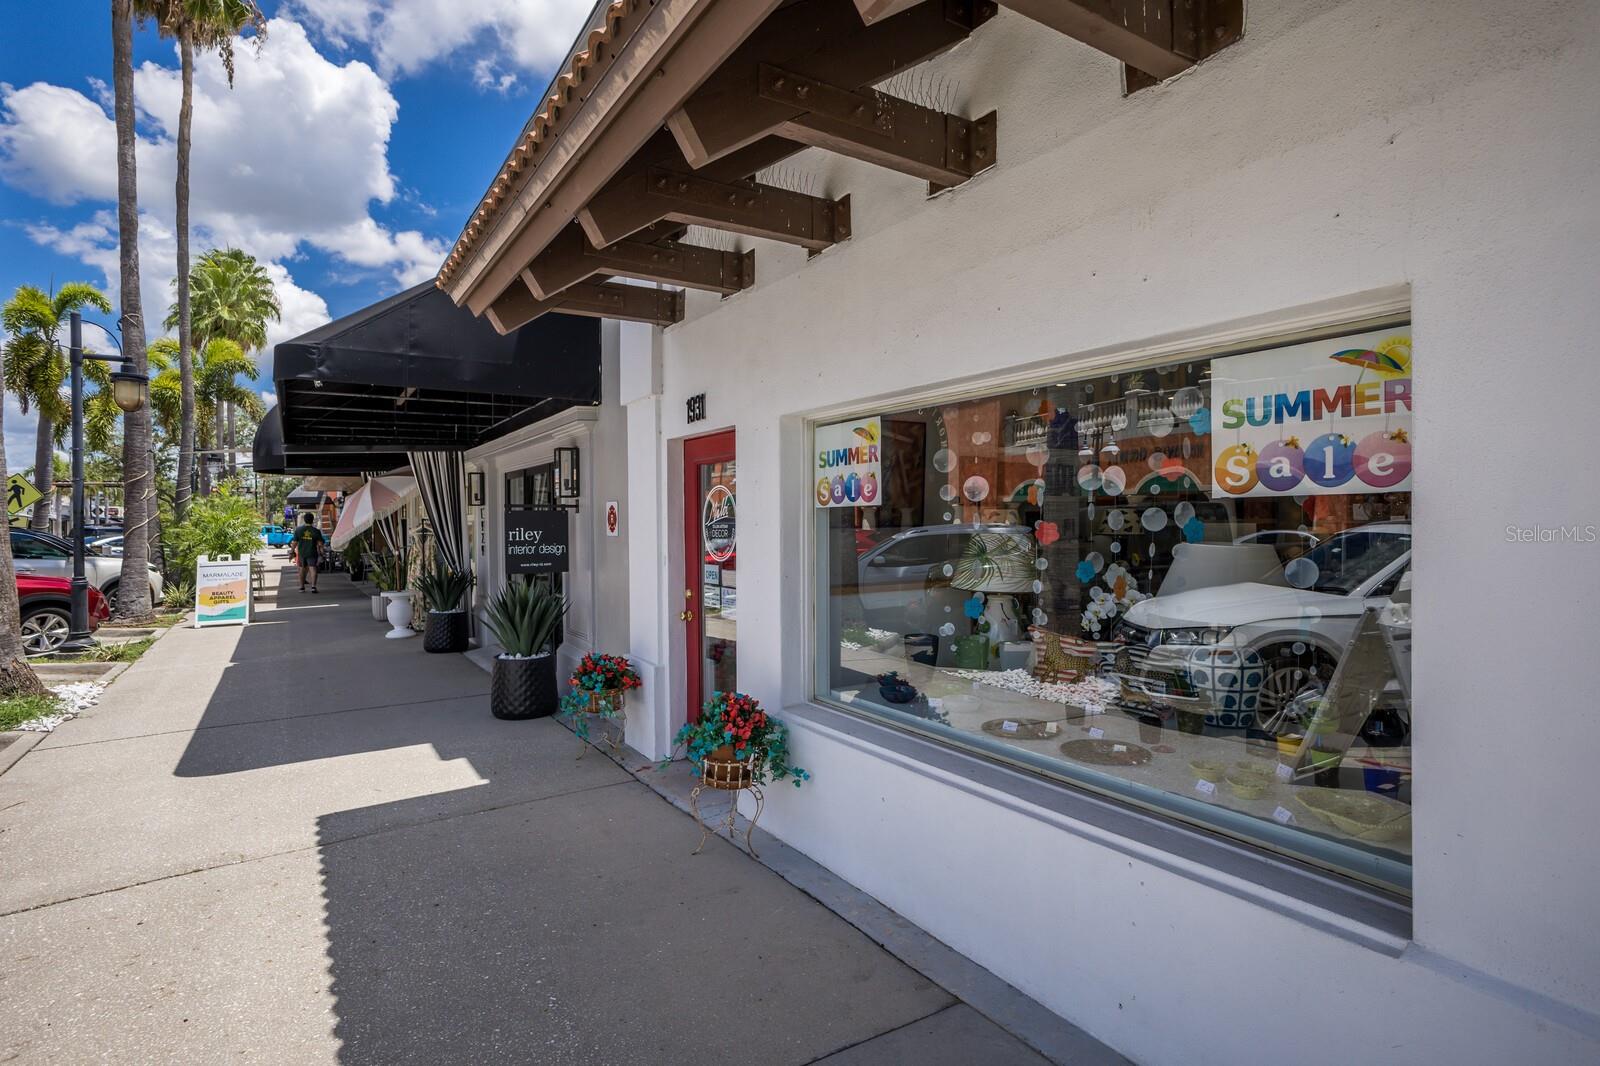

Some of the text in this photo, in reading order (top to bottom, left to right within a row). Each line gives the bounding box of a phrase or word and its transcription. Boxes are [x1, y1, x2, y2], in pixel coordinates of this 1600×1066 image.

[686, 392, 706, 424] 1931
[1222, 378, 1412, 429] SUMMER
[819, 444, 879, 469] SUMMER
[508, 527, 543, 544] riley
[508, 543, 567, 556] interior design
[705, 570, 718, 580] OPEN
